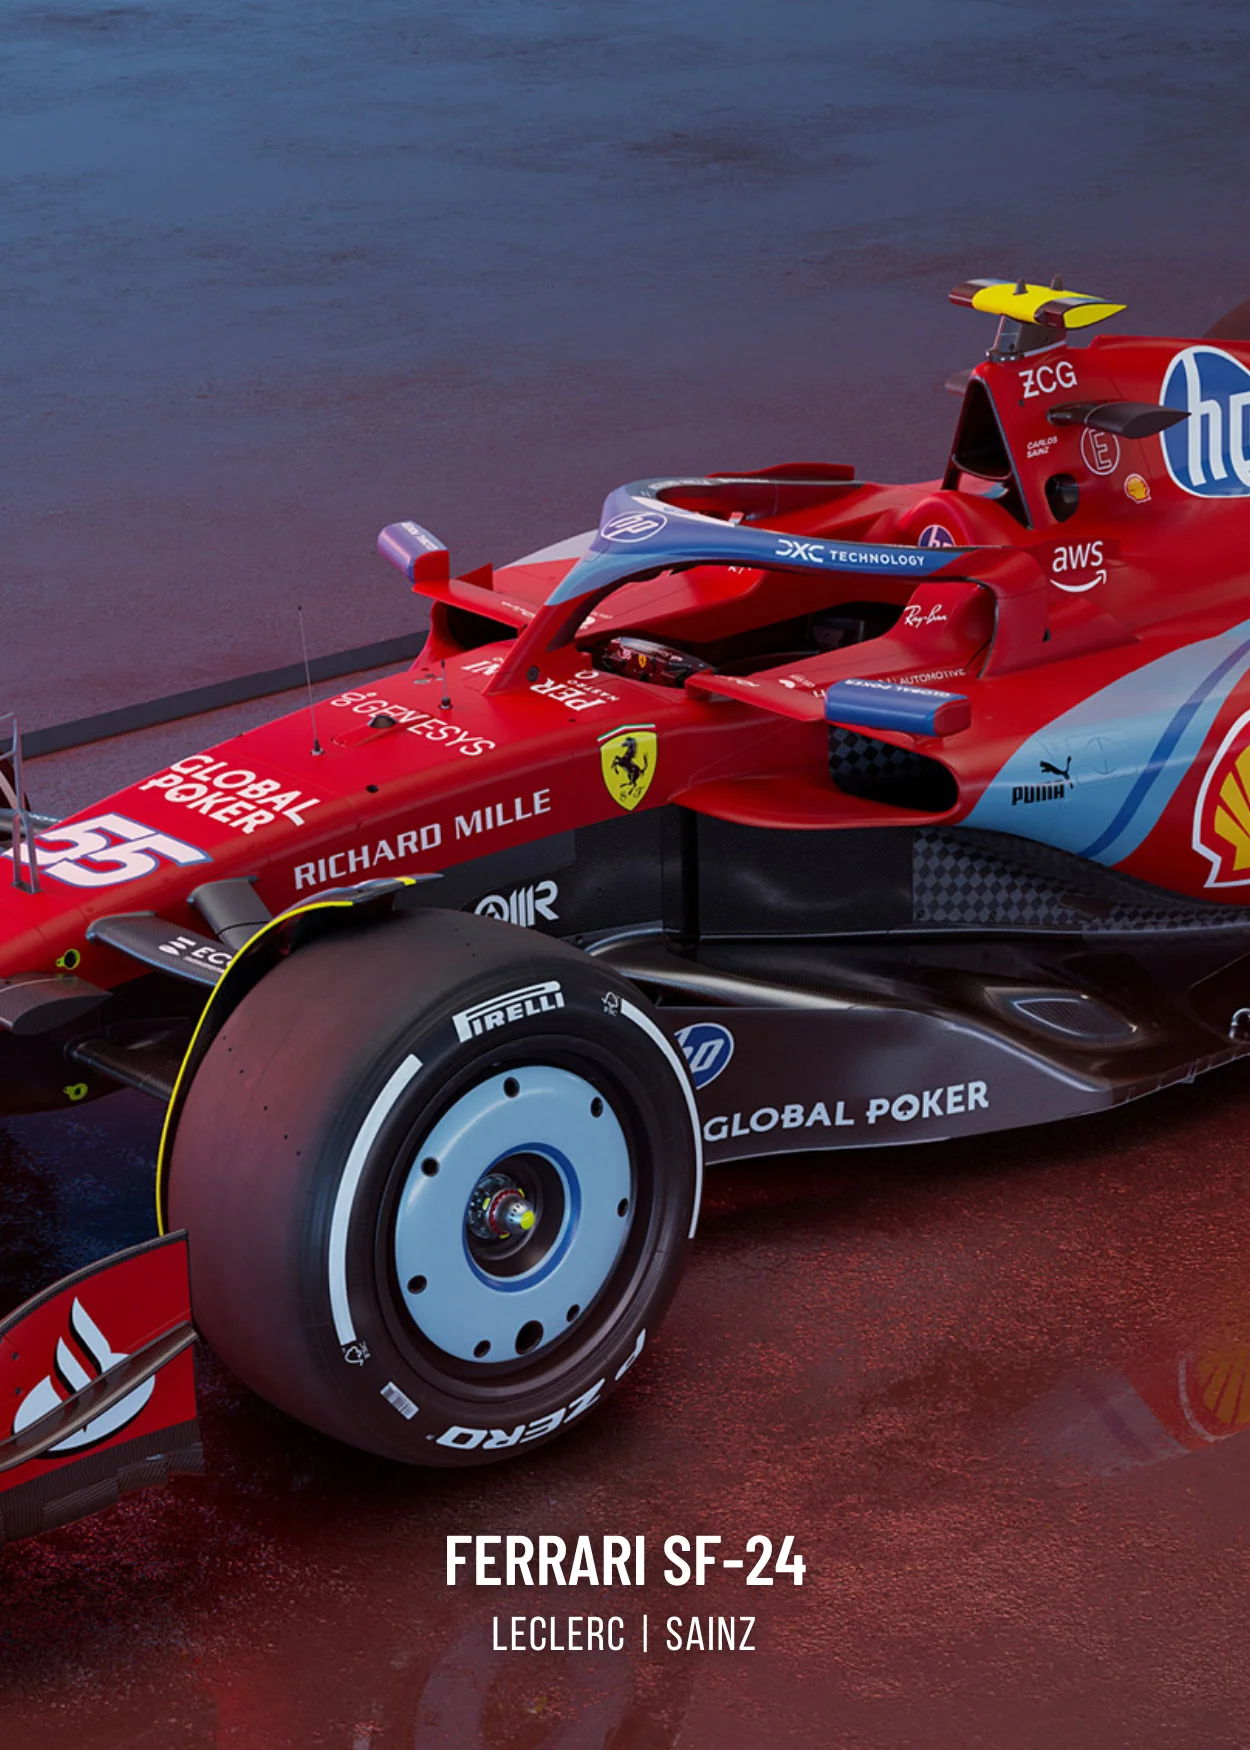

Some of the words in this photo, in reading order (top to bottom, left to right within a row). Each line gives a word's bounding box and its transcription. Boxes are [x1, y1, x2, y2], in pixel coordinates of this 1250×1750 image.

[1019, 361, 1077, 399] ZCG
[1027, 436, 1058, 450] CARLOS
[775, 539, 825, 563] DXC
[829, 549, 925, 566] TECHNOLOGY
[1052, 541, 1104, 573] aws
[904, 603, 947, 629] Ray-Ban
[567, 679, 620, 701] NASTRO
[900, 668, 966, 685] AUTOMOTIVE
[352, 699, 496, 756] GENESYS
[139, 774, 275, 834] POKER
[170, 755, 321, 827] GLOBAL
[1012, 784, 1065, 806] PUMA
[2, 812, 213, 888] 55
[293, 822, 442, 891] RICHARD
[454, 788, 551, 840] MILLE
[452, 980, 566, 1044] PIRELLI
[703, 1102, 855, 1142] GLOBAL
[866, 1080, 989, 1124] POKER
[436, 1377, 606, 1450] ZERO
